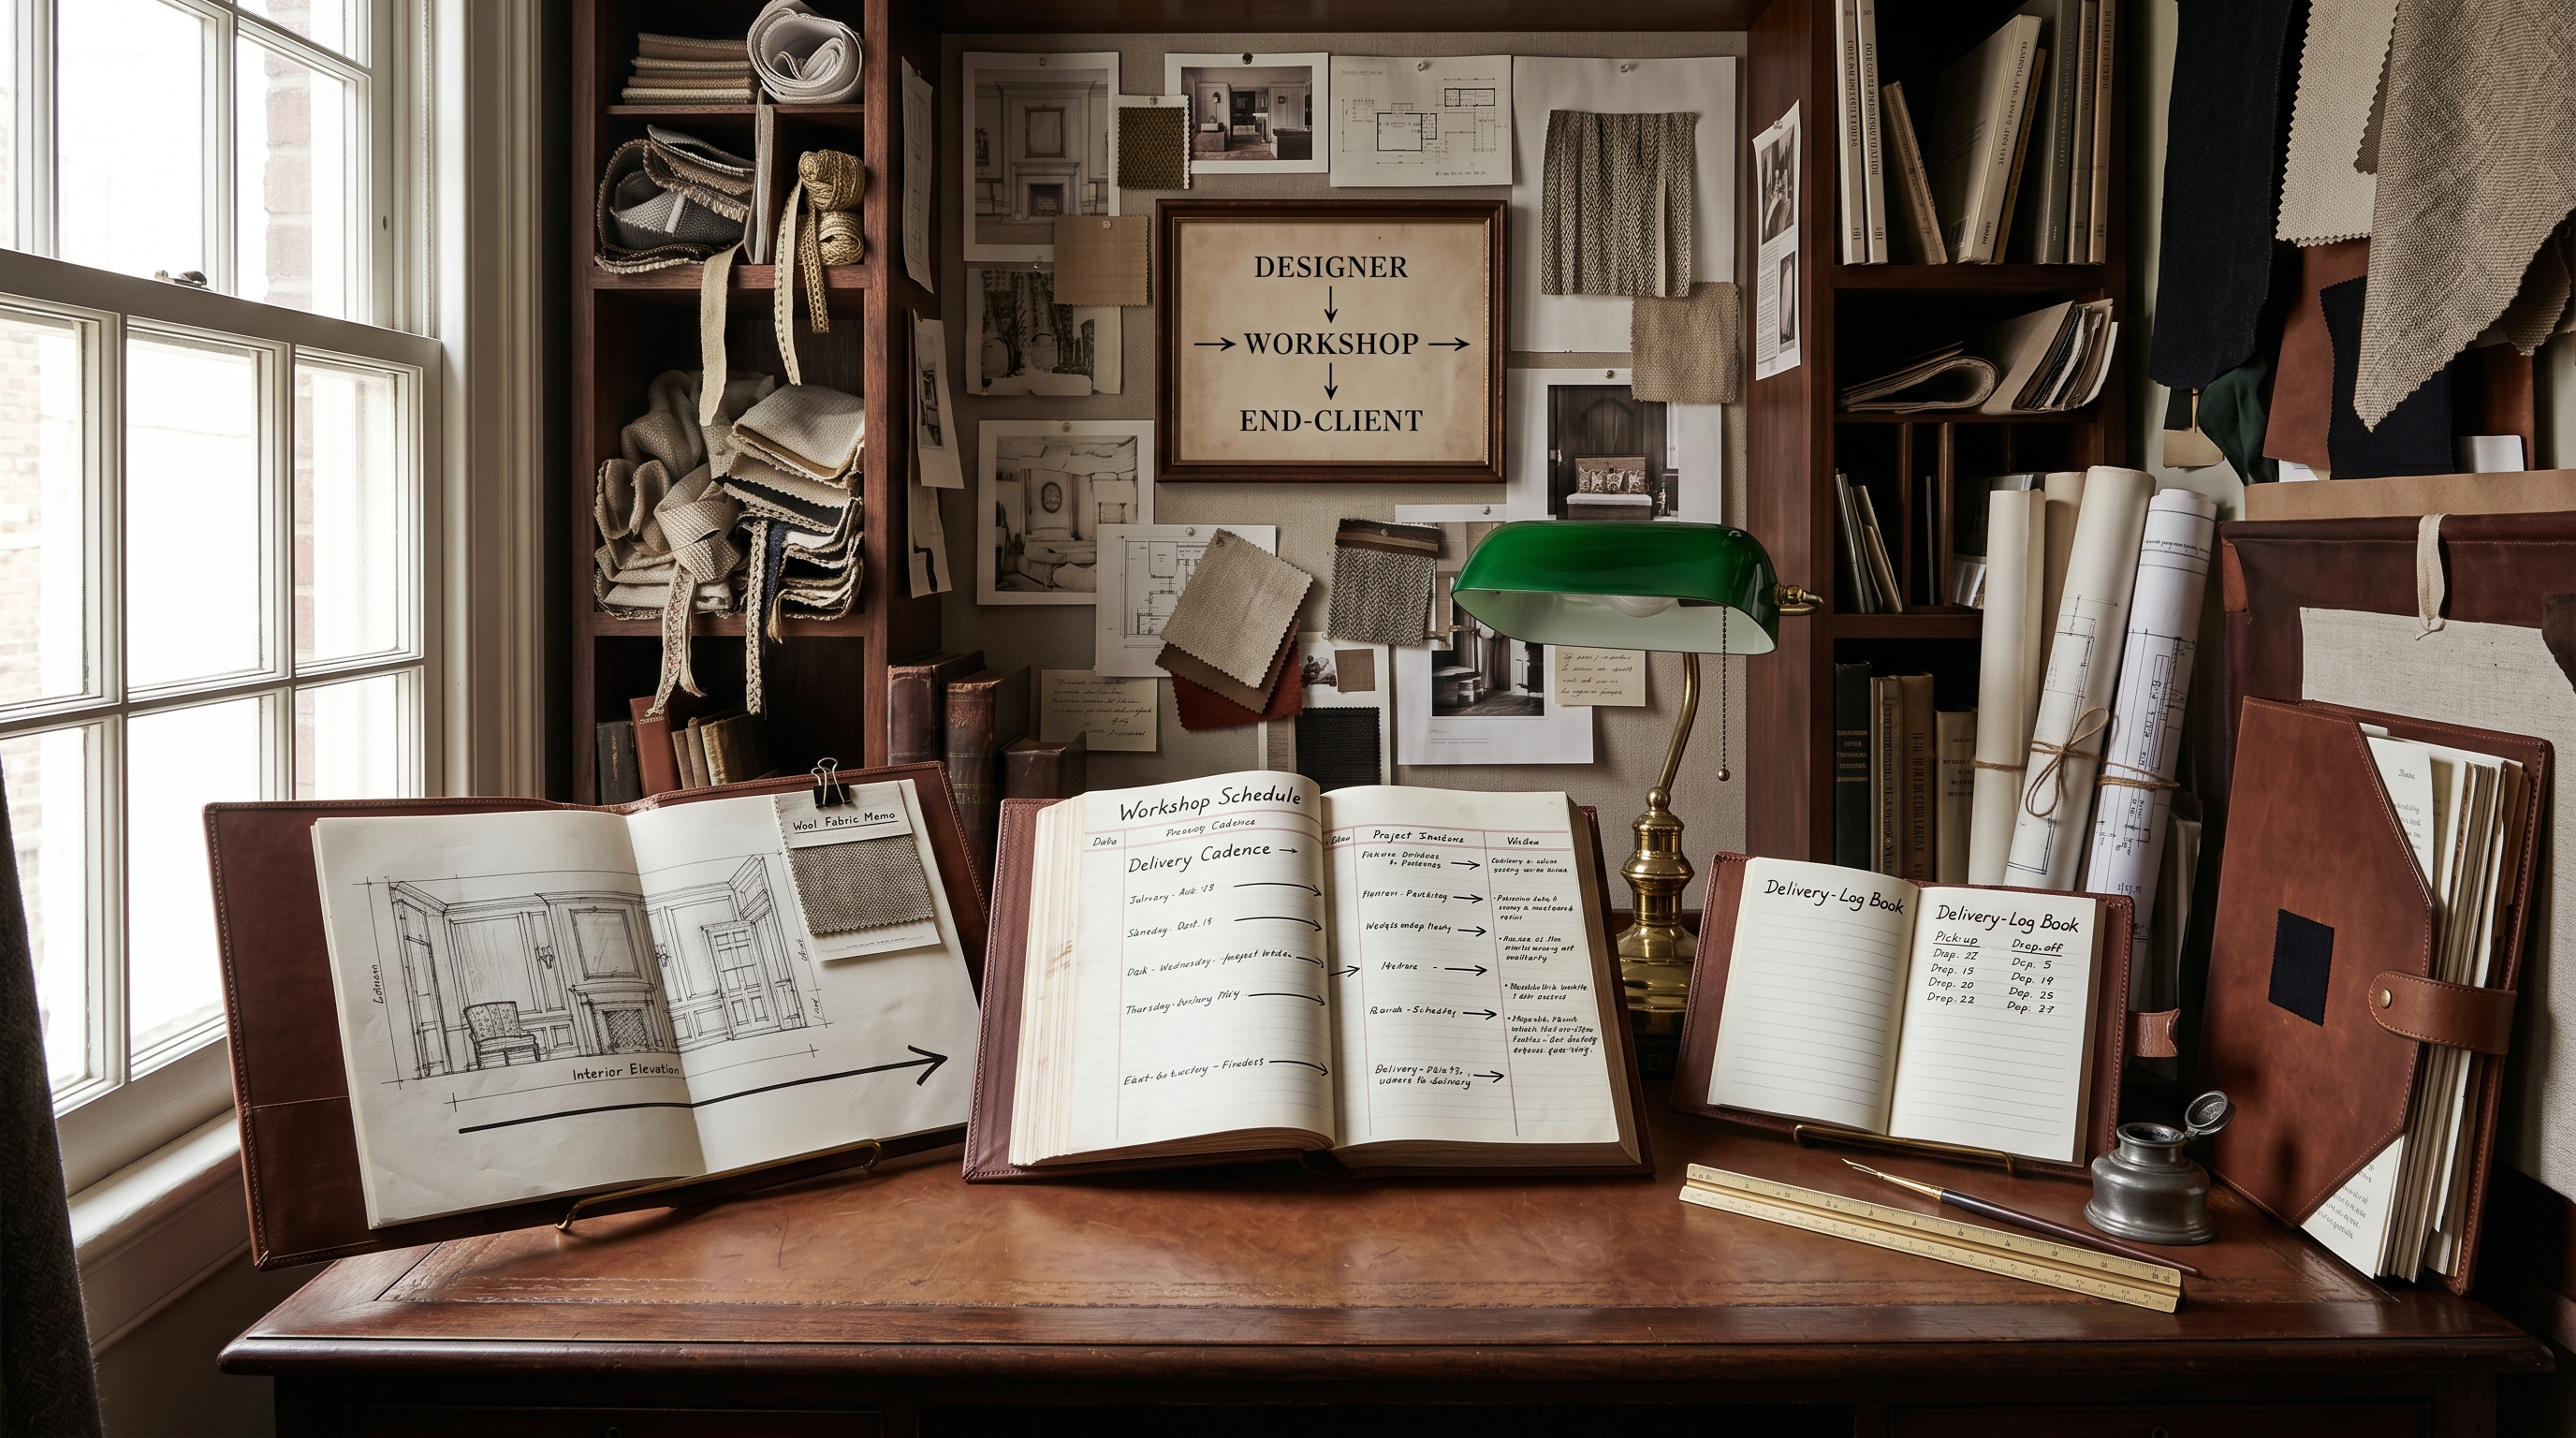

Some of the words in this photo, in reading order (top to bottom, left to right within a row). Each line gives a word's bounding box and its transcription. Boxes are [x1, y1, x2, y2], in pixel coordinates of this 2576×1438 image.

[1253, 255, 1409, 279] DESIGNER
[1243, 331, 1420, 356] WORKSHOP
[1238, 408, 1424, 433] END-CLIENT
[1120, 795, 1211, 822] Workshop
[1218, 785, 1302, 806] Schedule
[792, 819, 817, 831] Wool
[825, 815, 859, 829] Fabric
[864, 812, 896, 822] Memo
[1128, 853, 1193, 873] Delivery
[1201, 844, 1271, 862] Cadence
[1764, 879, 1865, 912] Delivery-Log
[1868, 891, 1905, 916] Book
[1935, 903, 2036, 934] Delivery-Log
[2039, 913, 2080, 933] Book
[2042, 960, 2053, 969] 5
[1959, 994, 1975, 1005] 22
[1960, 981, 1974, 990] 20
[2039, 990, 2054, 1000] 25
[572, 1067, 623, 1080] Interior
[629, 1063, 680, 1076] Elevation
